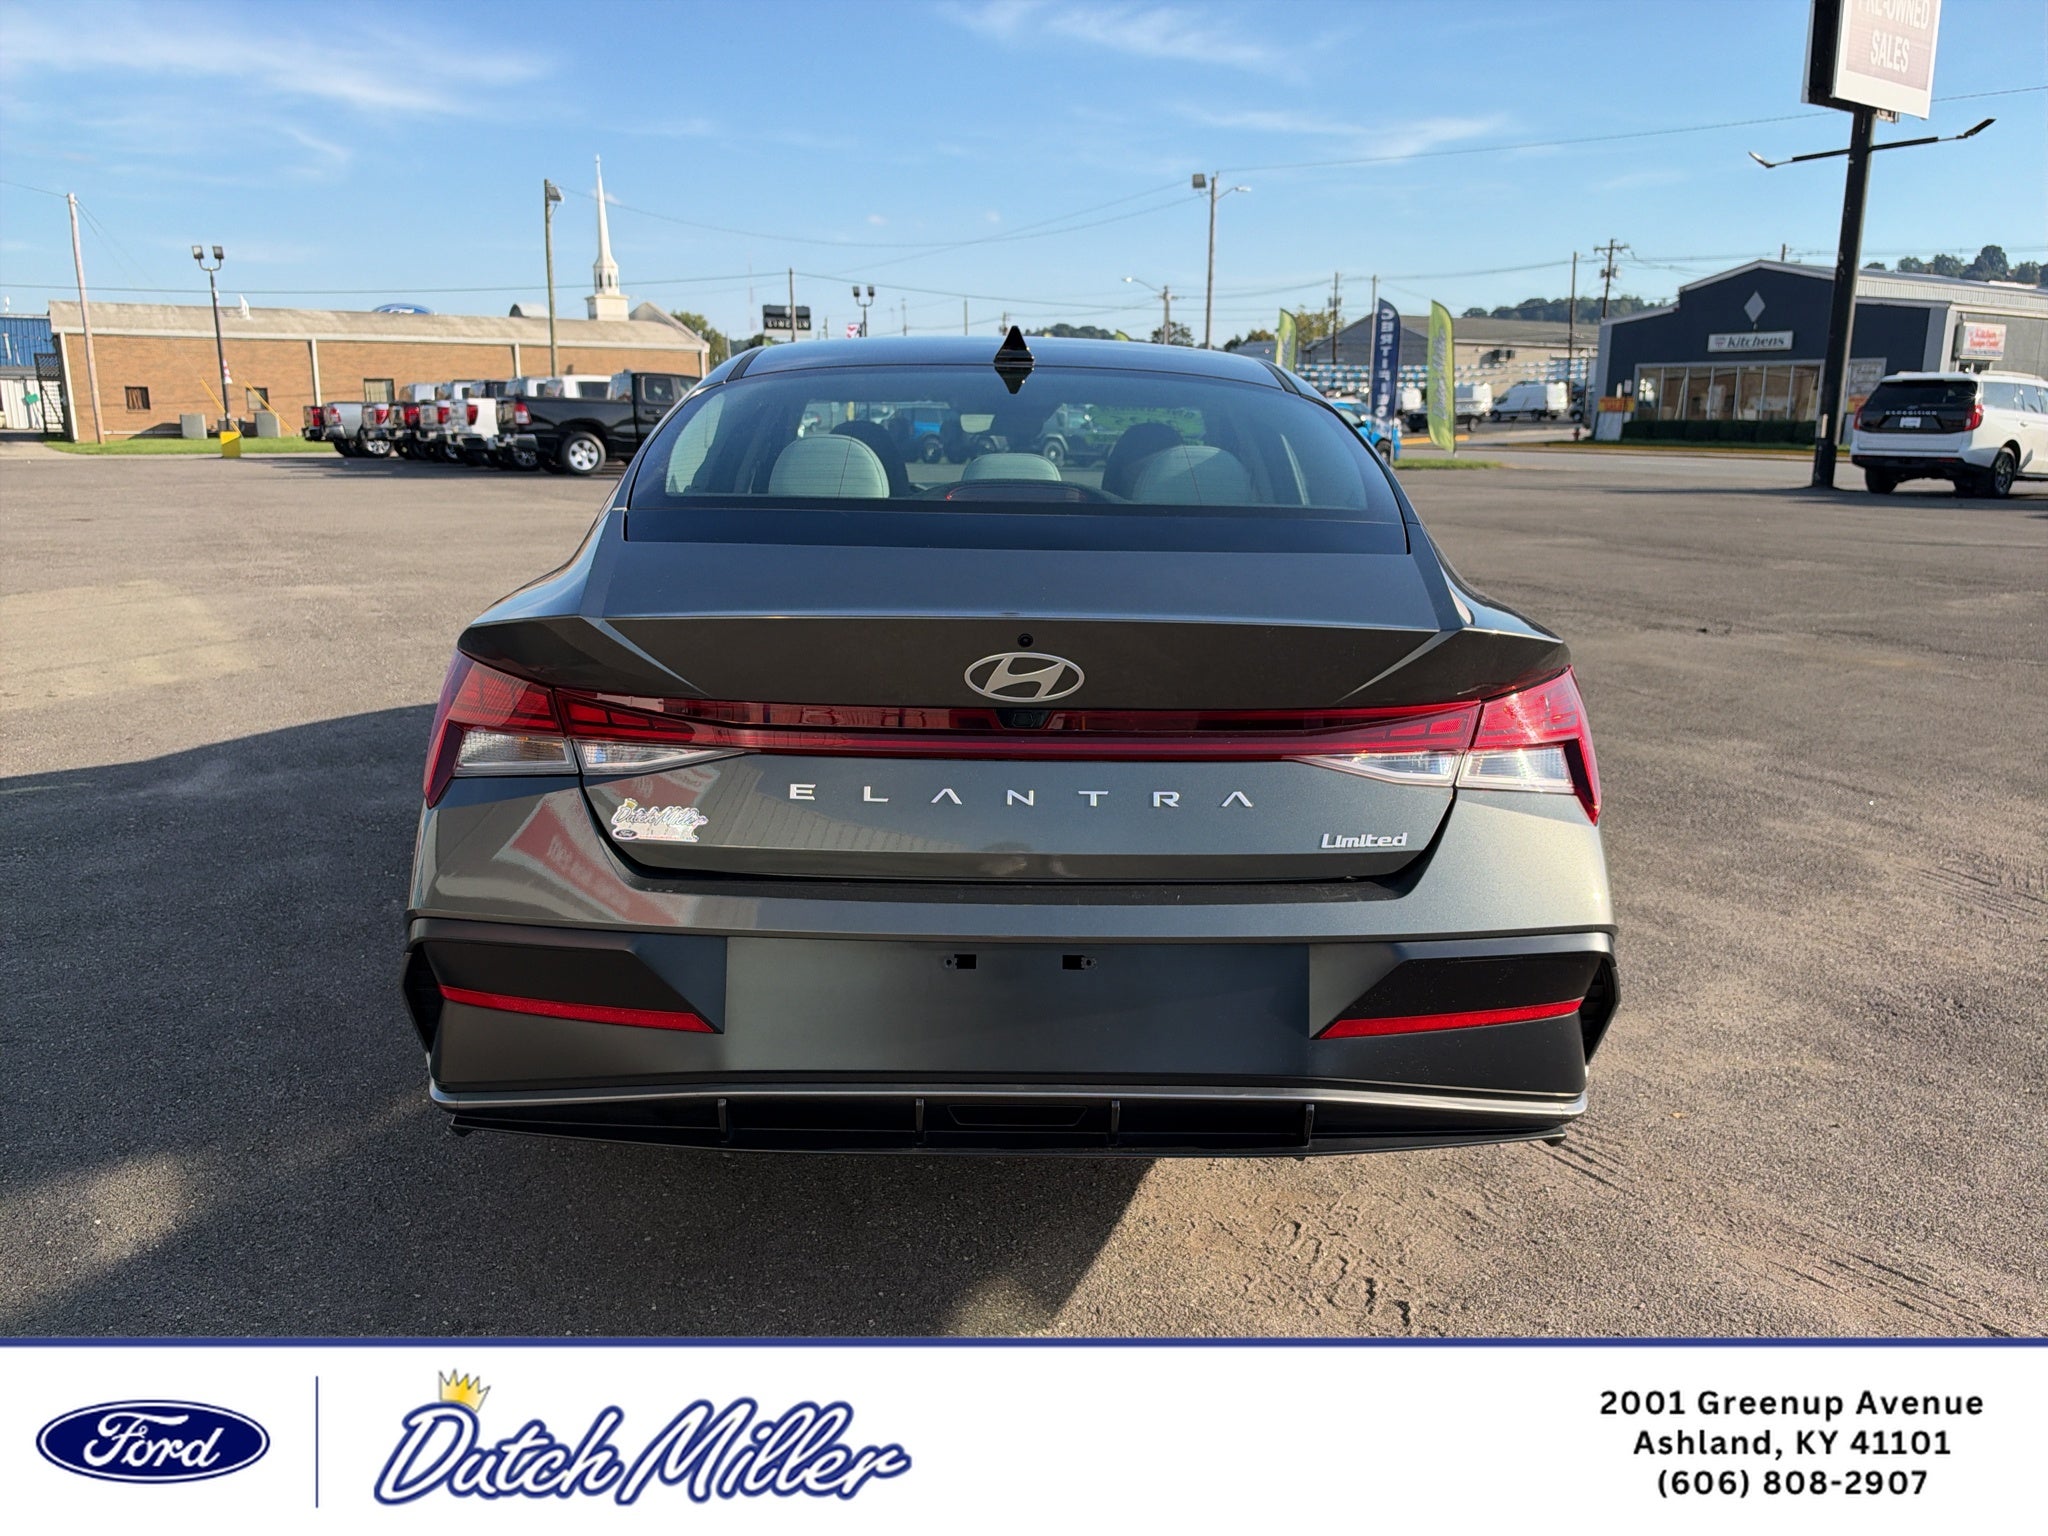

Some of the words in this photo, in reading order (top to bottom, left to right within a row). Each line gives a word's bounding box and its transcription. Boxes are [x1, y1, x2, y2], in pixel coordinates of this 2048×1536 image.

[1870, 29, 1910, 73] SALES
[768, 320, 808, 328] LINCLN
[789, 783, 1253, 808] ELANTRA
[615, 807, 656, 825] Dutch
[1321, 832, 1407, 848] Limited
